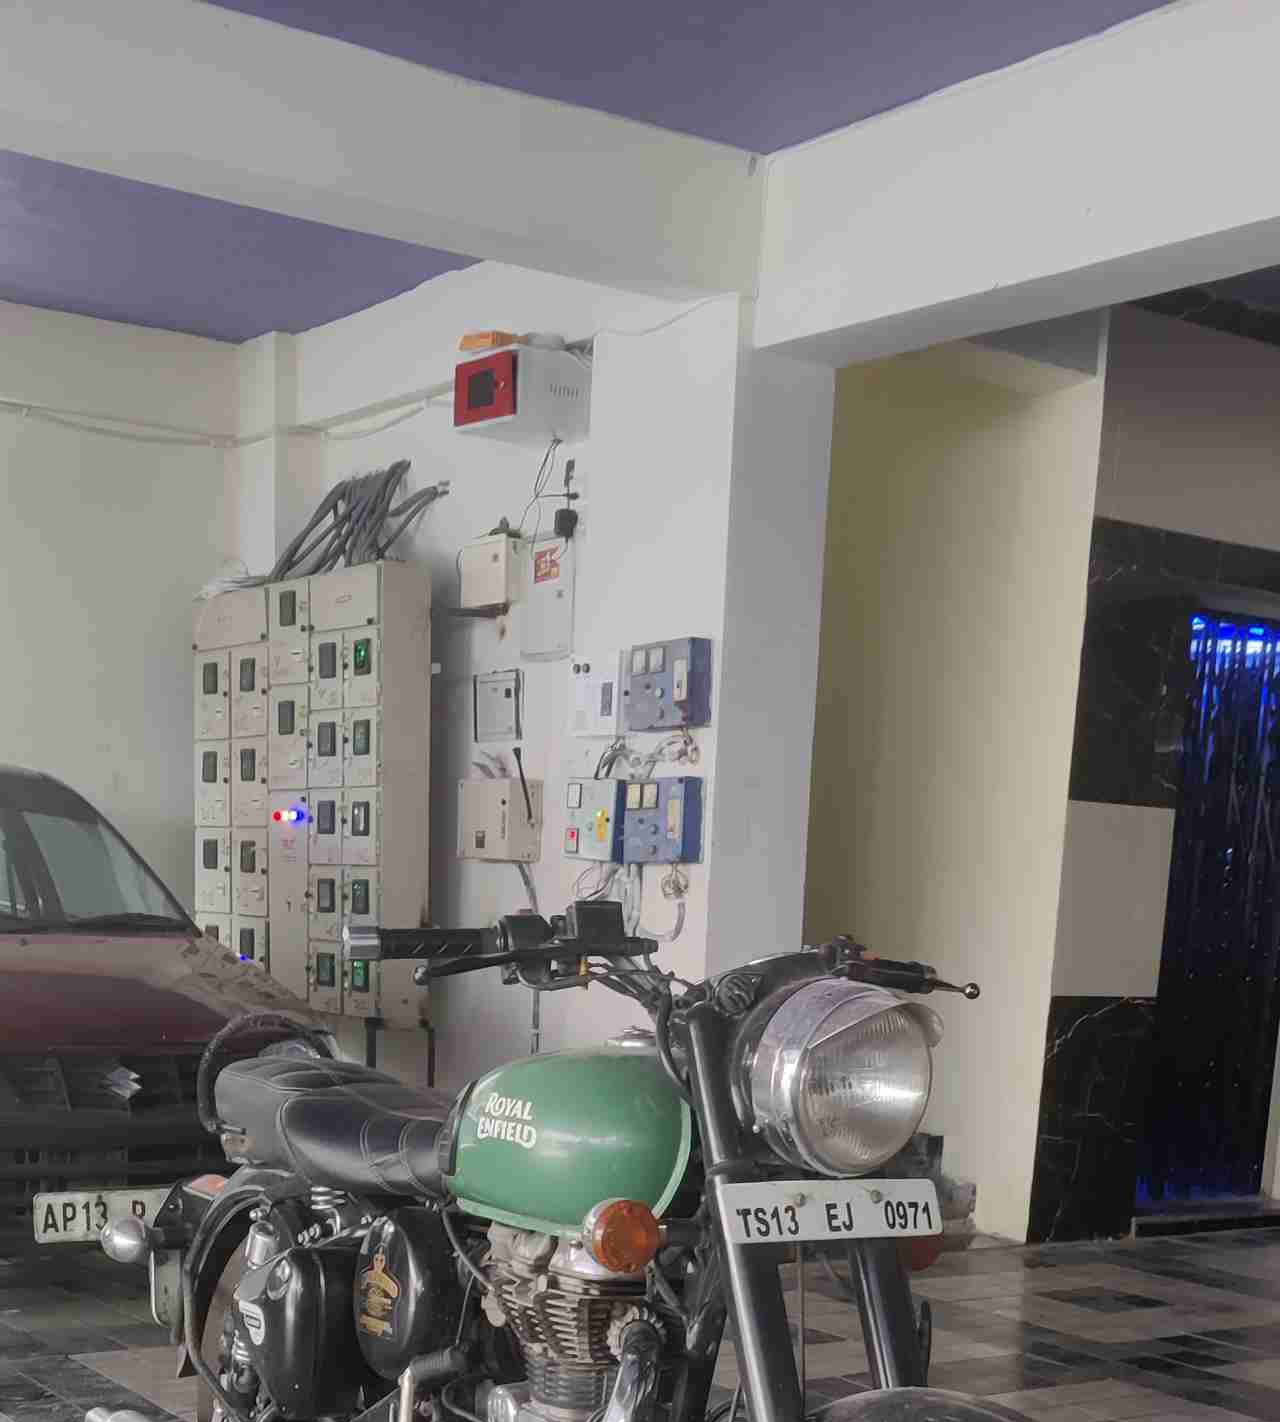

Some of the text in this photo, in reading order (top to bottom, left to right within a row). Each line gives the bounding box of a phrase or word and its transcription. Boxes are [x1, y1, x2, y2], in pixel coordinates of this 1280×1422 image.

[485, 1092, 533, 1120] ROYAL
[477, 1117, 537, 1149] ENFIELD
[42, 1200, 108, 1234] AP13
[736, 1200, 933, 1238] TS13 EJ 0971
